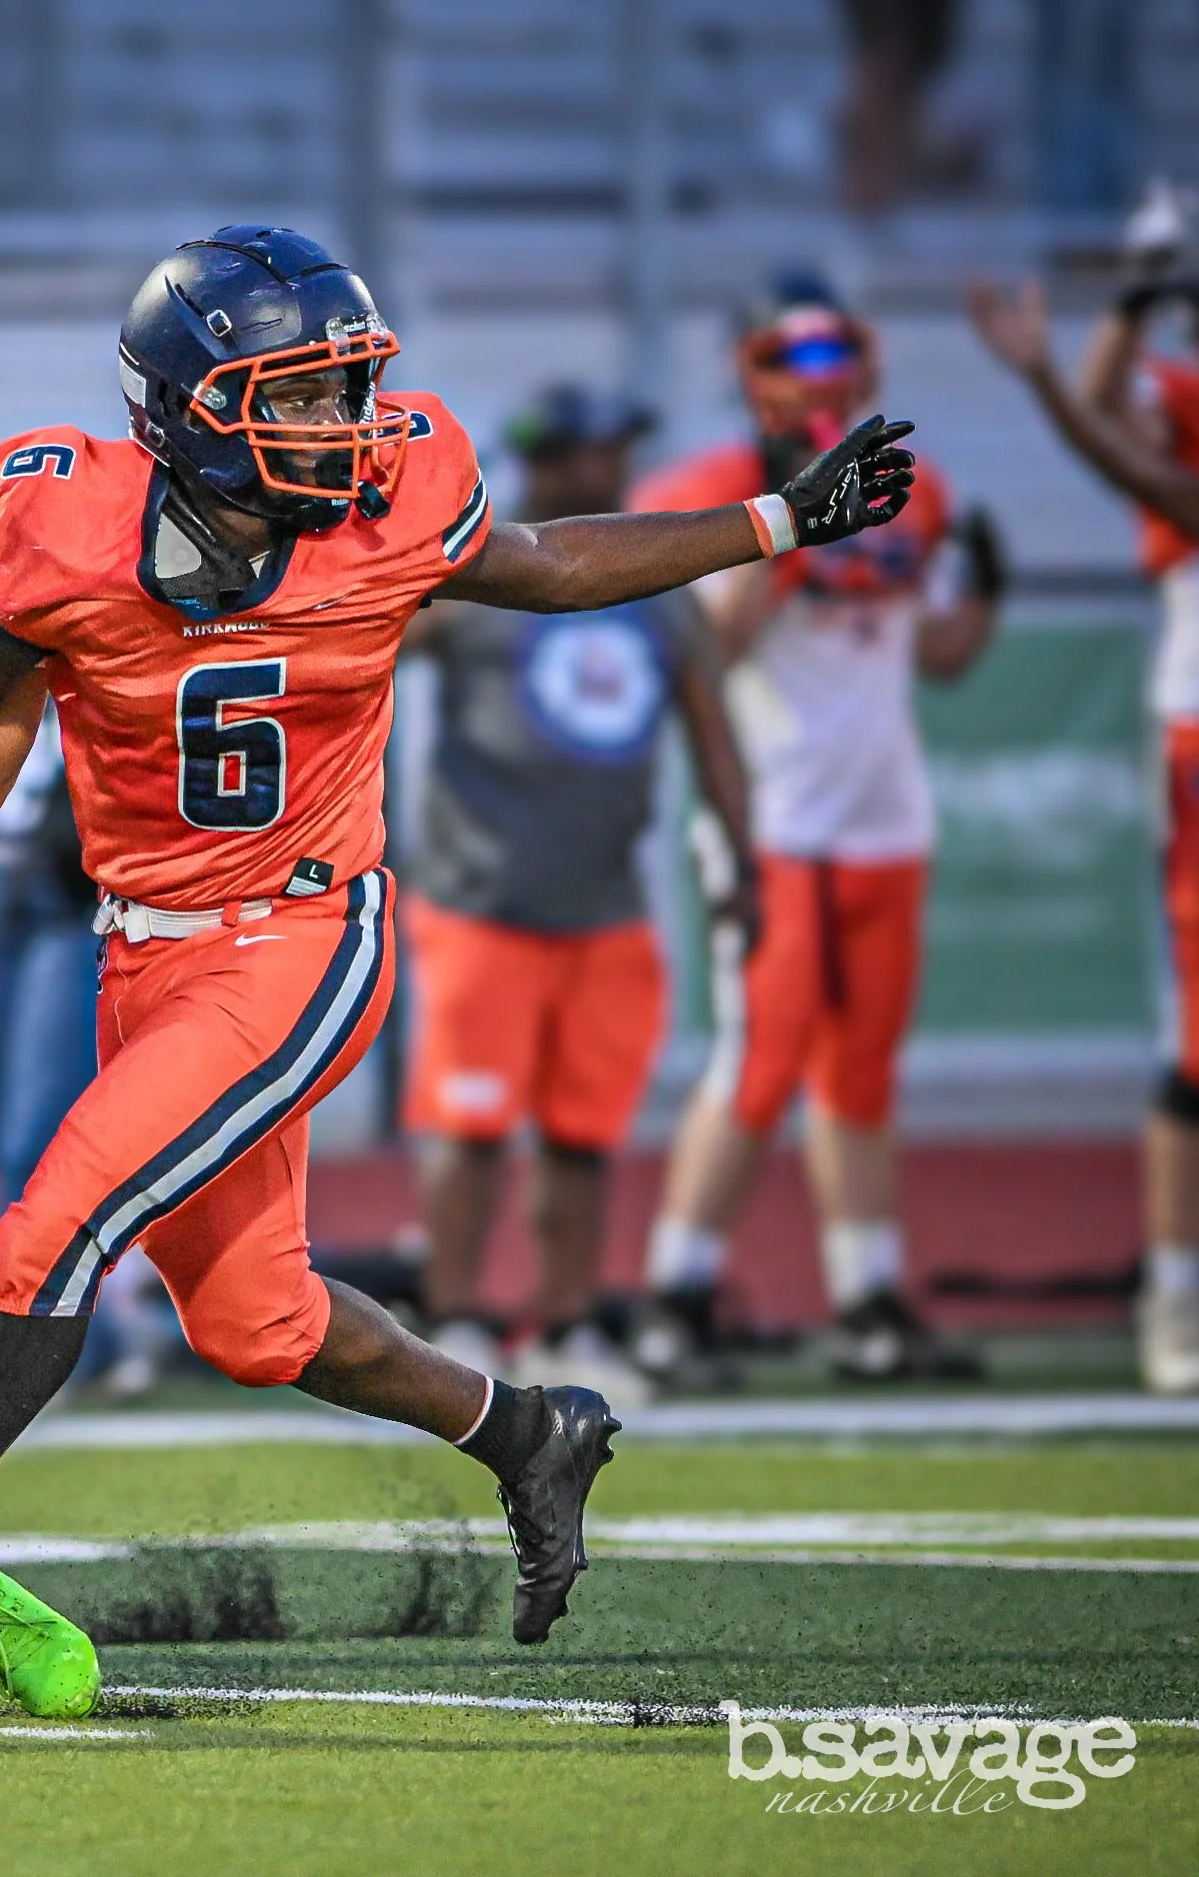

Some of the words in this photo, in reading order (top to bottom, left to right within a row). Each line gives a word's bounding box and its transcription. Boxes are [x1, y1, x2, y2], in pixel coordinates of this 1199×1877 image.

[0, 444, 77, 480] 6
[176, 657, 287, 832] 6
[309, 864, 319, 879] L
